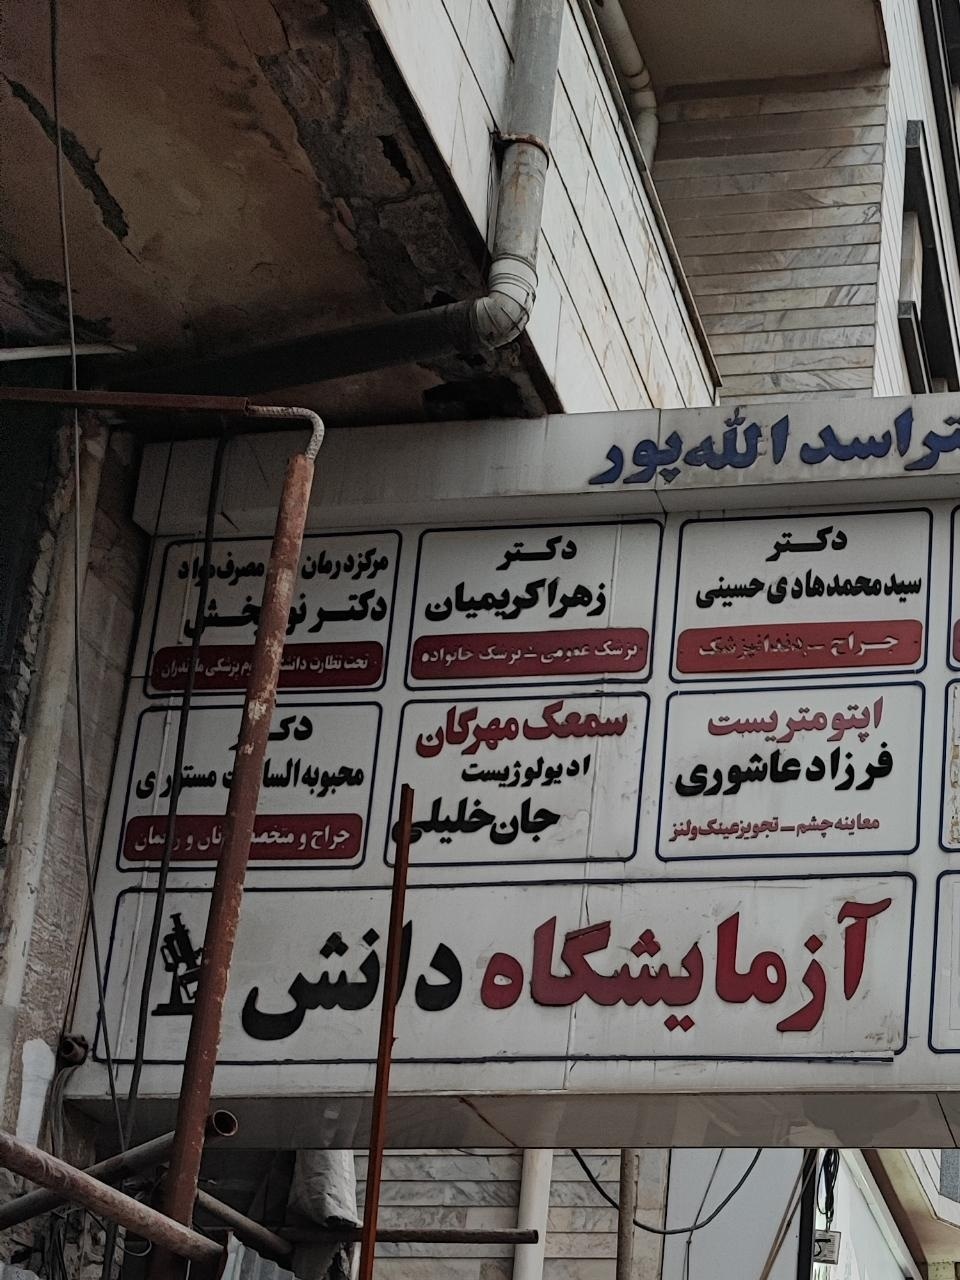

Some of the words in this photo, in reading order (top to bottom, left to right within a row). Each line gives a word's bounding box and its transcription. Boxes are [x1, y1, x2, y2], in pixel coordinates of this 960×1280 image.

[495, 535, 577, 571] دکتر
[766, 525, 847, 562] دکتر
[216, 551, 264, 586] مصرف
[300, 549, 355, 580] درمان
[352, 547, 388, 580] مرکز
[425, 578, 546, 621] کریمیان
[549, 577, 606, 618] زهرا
[696, 576, 765, 609] حسینی
[767, 568, 826, 604] هادی
[884, 573, 921, 602] سید
[308, 589, 387, 633] دکتر
[421, 650, 474, 667] خانواده
[540, 647, 589, 663] عمومی
[831, 632, 898, 656] جراح
[205, 657, 241, 679] پزشکی
[309, 656, 343, 674] نظارت
[343, 656, 368, 672] تحت
[523, 700, 628, 740] سمعک
[707, 696, 884, 743] اپتومتریست
[302, 764, 364, 797] محبوبه
[461, 754, 591, 787] ادیولوژیست
[675, 749, 801, 797] عاشوری
[805, 741, 894, 791] فرزاد
[311, 823, 350, 850] جراح
[391, 797, 496, 844] خلیلی
[490, 797, 561, 844] جان
[701, 818, 739, 837] عینک
[736, 816, 779, 840] تجویز
[796, 815, 833, 838] چشم
[835, 813, 880, 836] معاینه
[299, 832, 307, 850] و
[240, 919, 463, 1042] دانش
[481, 897, 893, 1032] آزمایشگاه
